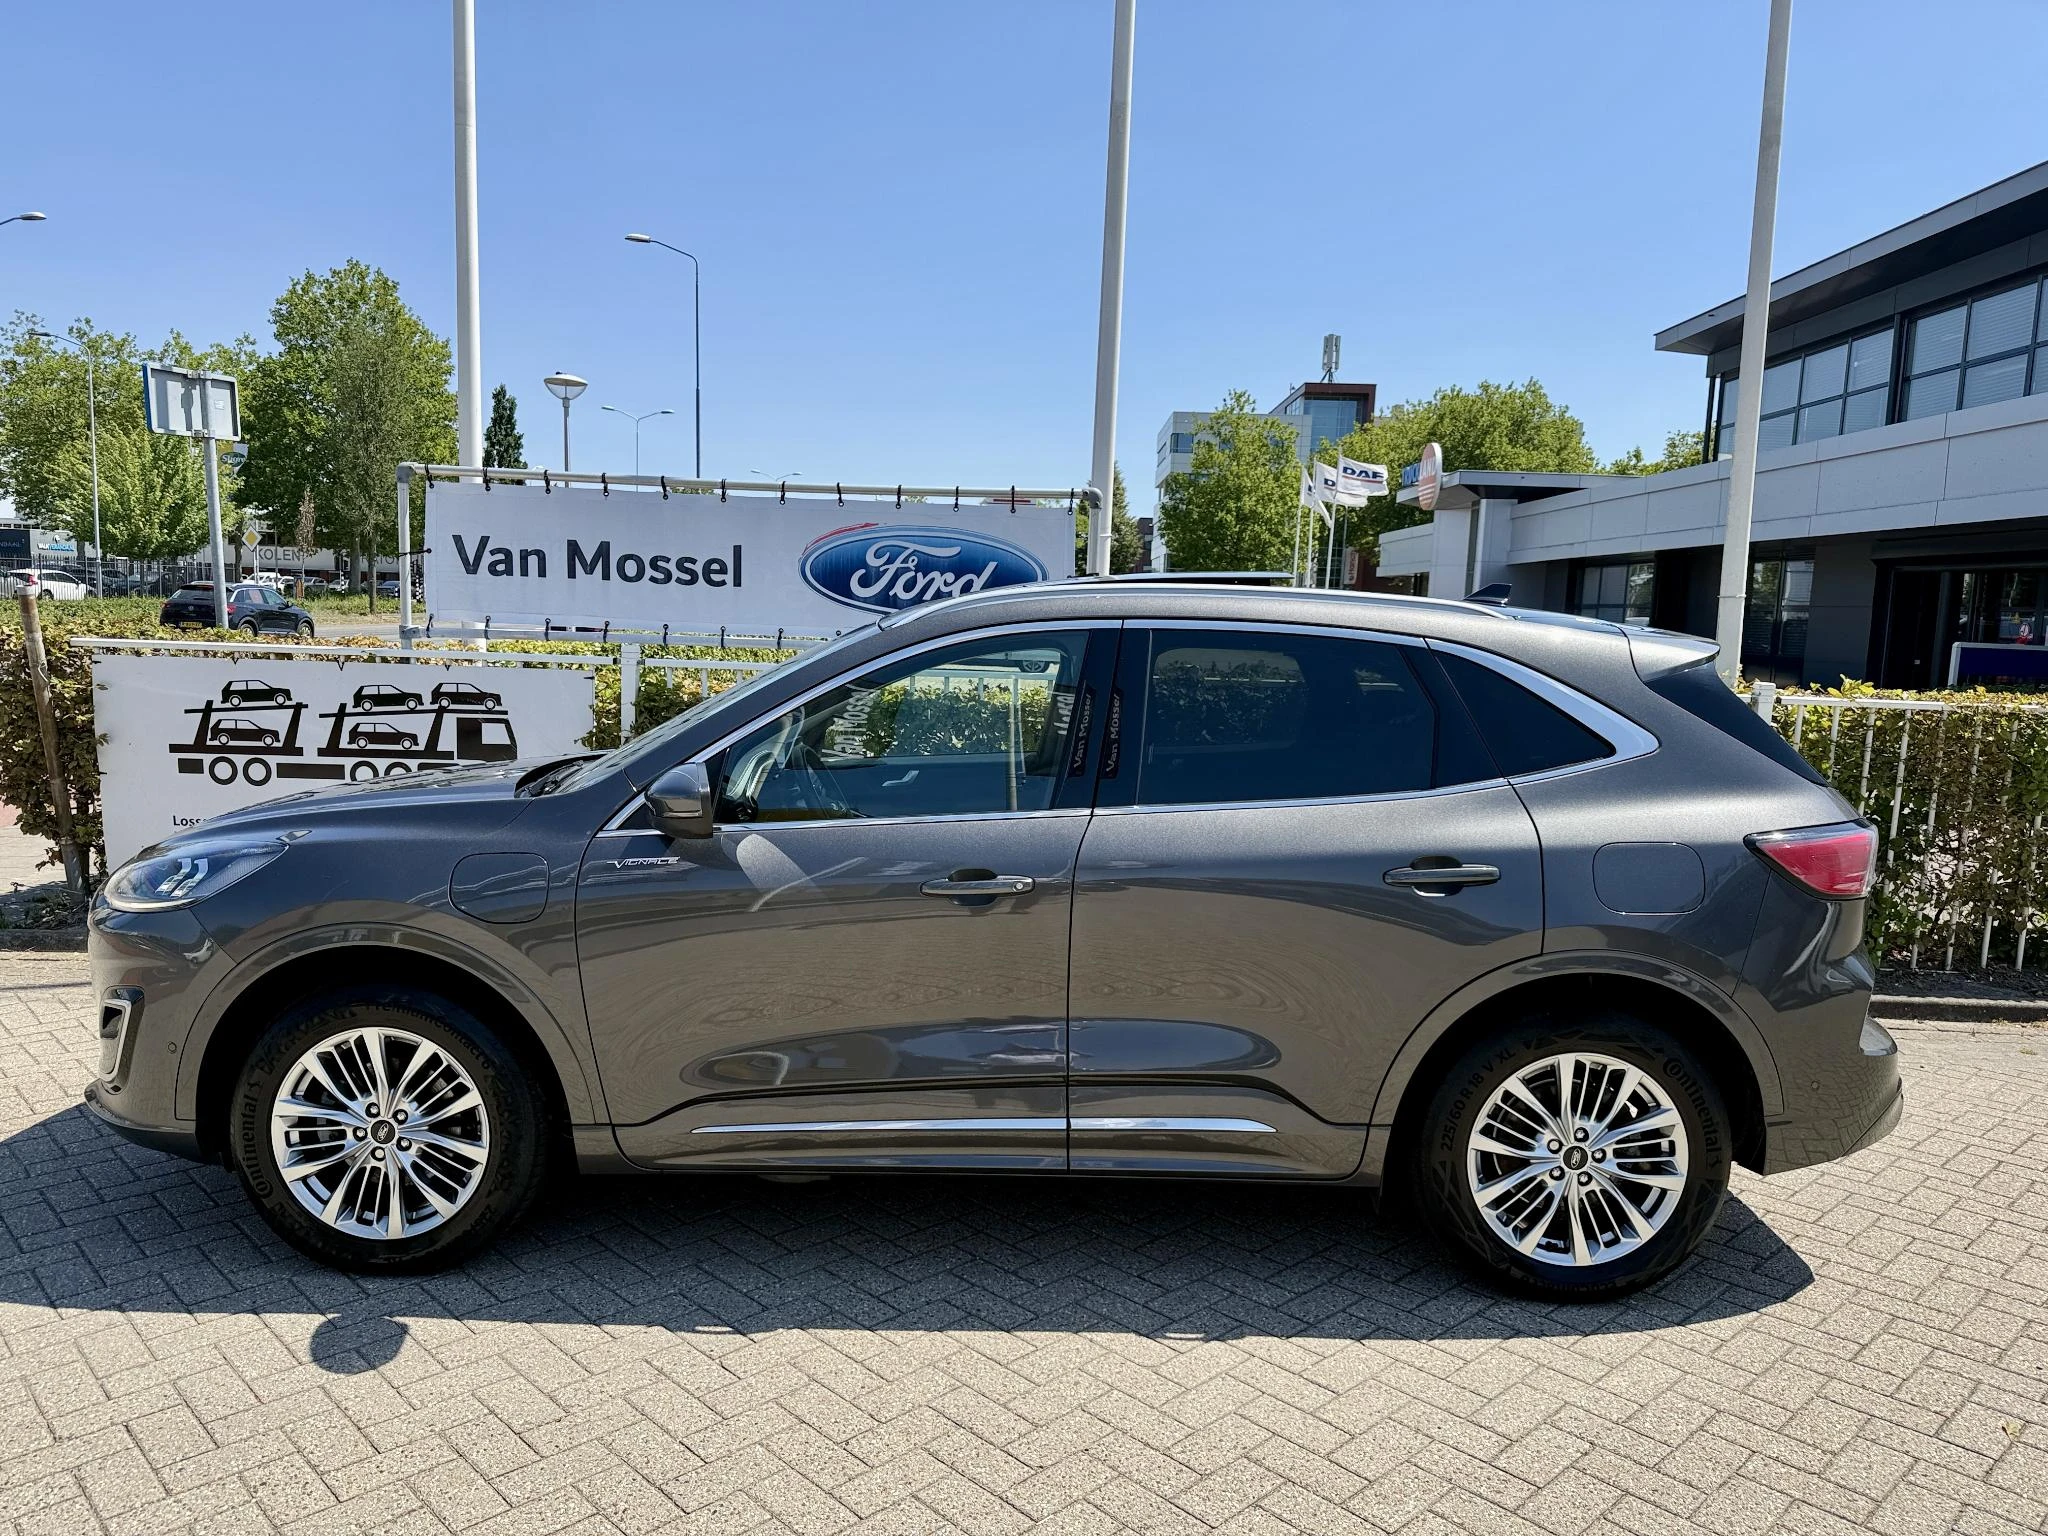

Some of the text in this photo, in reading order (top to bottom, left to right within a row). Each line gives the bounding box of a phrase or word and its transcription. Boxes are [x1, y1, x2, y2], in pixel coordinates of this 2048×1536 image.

[1342, 466, 1385, 479] DAF
[452, 534, 742, 588] Van Mossel
[850, 540, 998, 600] Ford
[1074, 693, 1092, 768] Van Mossel
[1106, 693, 1120, 772] Van Mossel
[1441, 1099, 1466, 1152] 225/60
[1663, 1058, 1722, 1152] Continental
[241, 1094, 273, 1199] Continental
